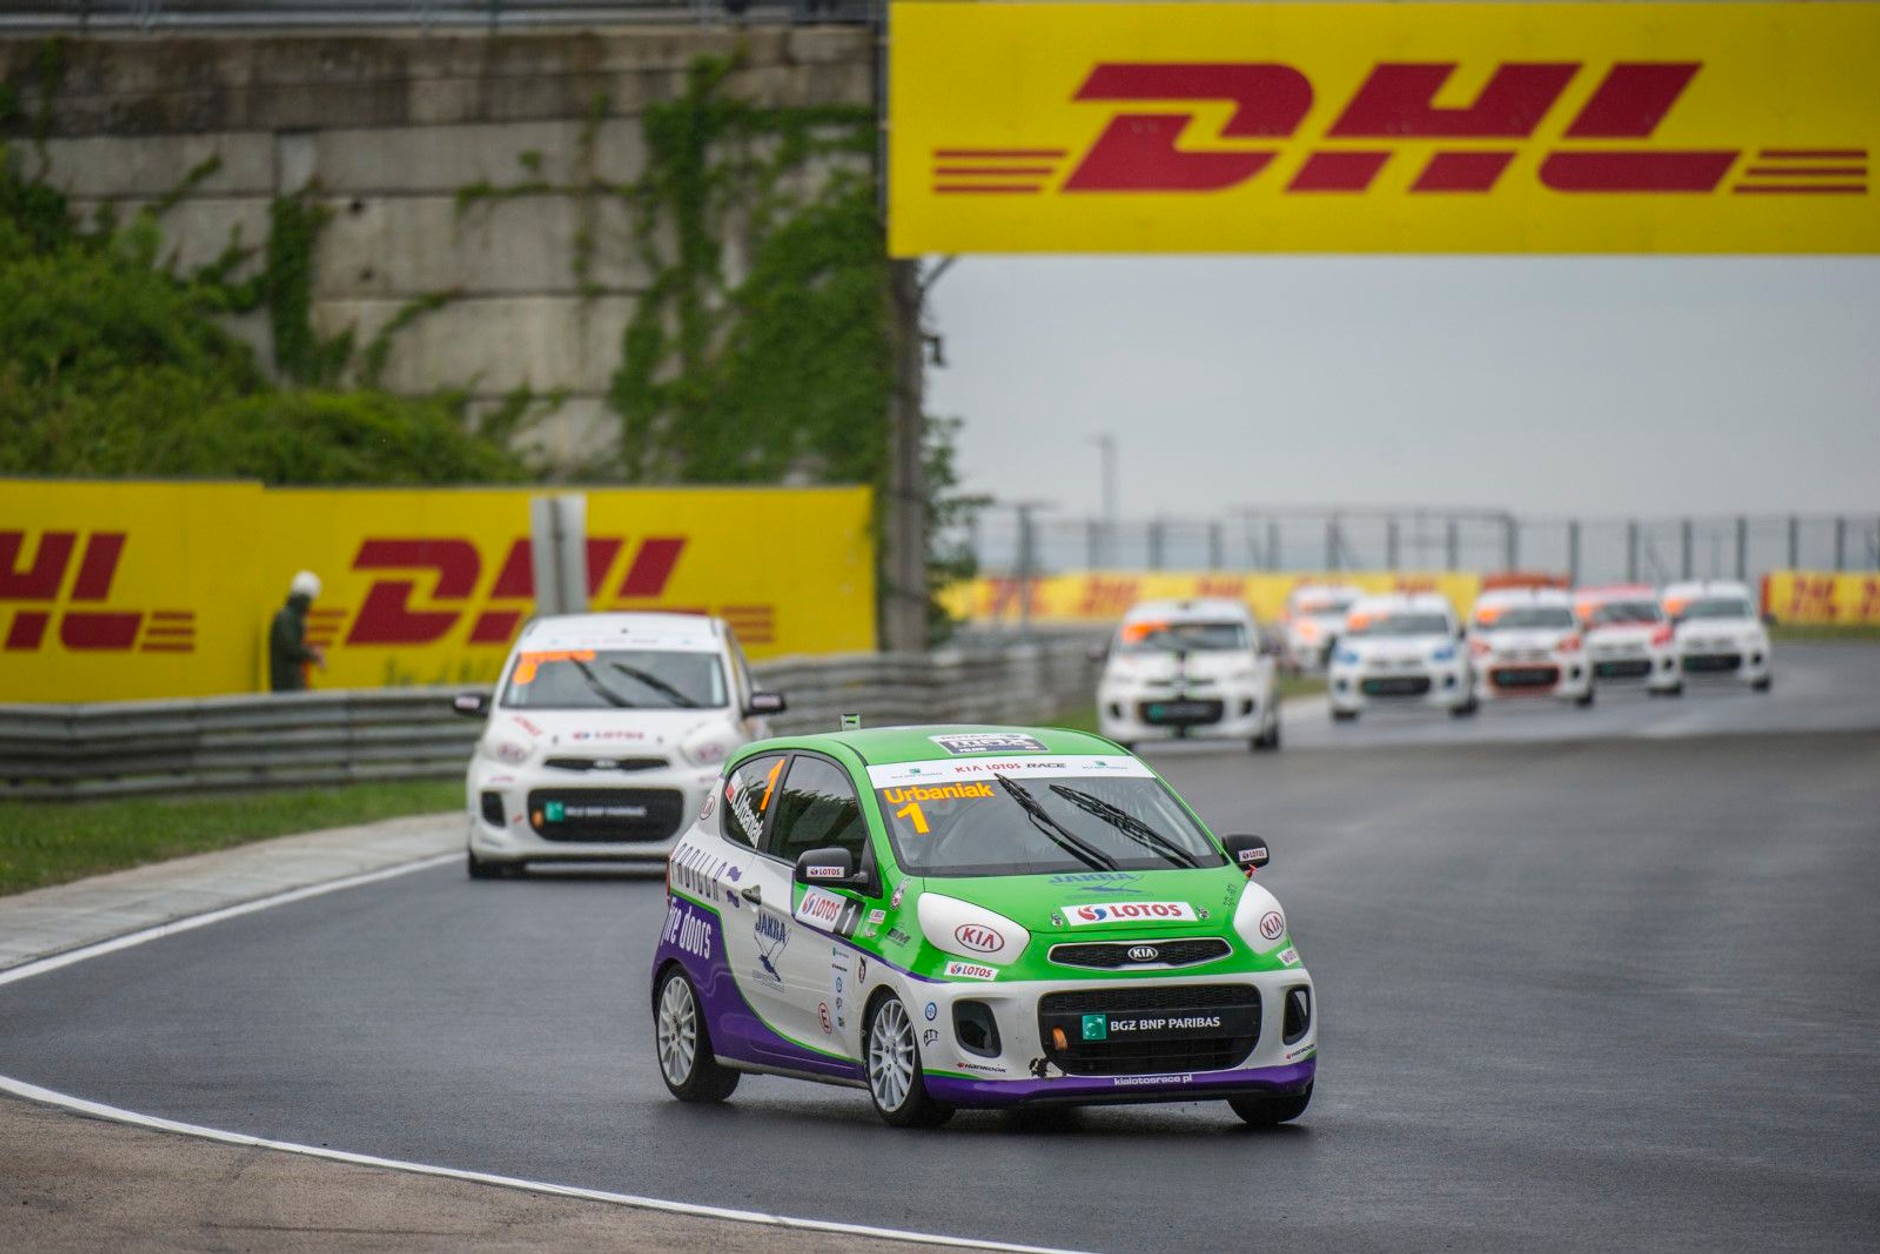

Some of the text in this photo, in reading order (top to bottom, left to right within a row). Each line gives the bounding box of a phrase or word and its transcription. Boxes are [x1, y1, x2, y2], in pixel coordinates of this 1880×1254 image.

[1058, 62, 1743, 193] DHL
[955, 765, 982, 773] KIA
[760, 759, 785, 811] 1
[884, 781, 995, 804] Urbaniak
[896, 802, 931, 834] 1
[819, 868, 841, 876] LOTOS
[811, 898, 840, 922] LOTOS
[842, 904, 857, 935] 1
[1109, 903, 1183, 919] LOTOS
[679, 905, 712, 960] doors
[755, 911, 785, 944] JAKRA
[961, 926, 994, 950] KIA
[1262, 916, 1283, 937] KIA
[1132, 947, 1155, 959] KIA
[962, 966, 993, 978] LOTOS
[1139, 1018, 1166, 1030] BNP
[1168, 1016, 1221, 1029] PARIBAS
[1113, 1074, 1193, 1086] kialotosrace.pl
